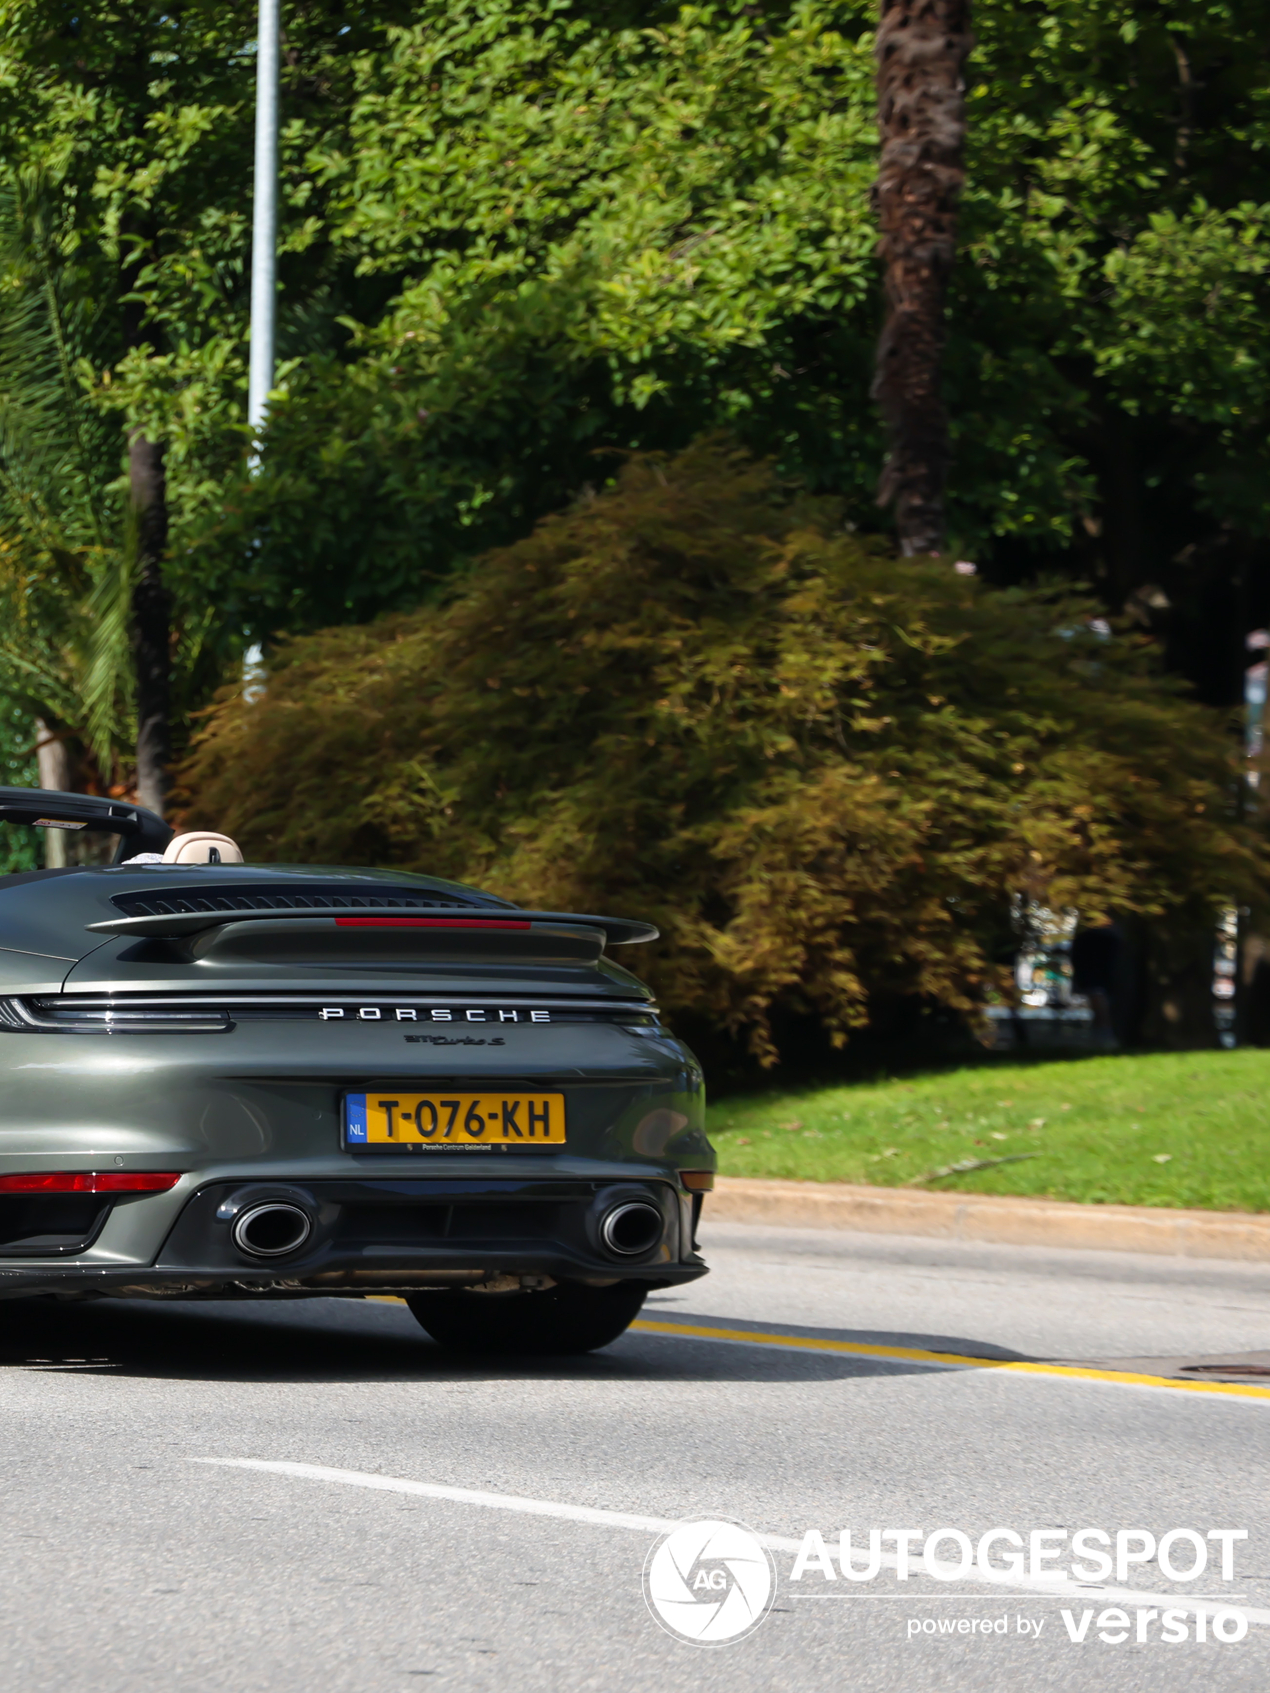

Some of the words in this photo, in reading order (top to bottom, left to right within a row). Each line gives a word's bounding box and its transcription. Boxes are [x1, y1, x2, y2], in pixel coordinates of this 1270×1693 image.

[319, 1007, 551, 1022] PORSCHE
[378, 1100, 550, 1138] T-076-KH
[349, 1123, 364, 1136] NL
[422, 1143, 442, 1151] Porsche
